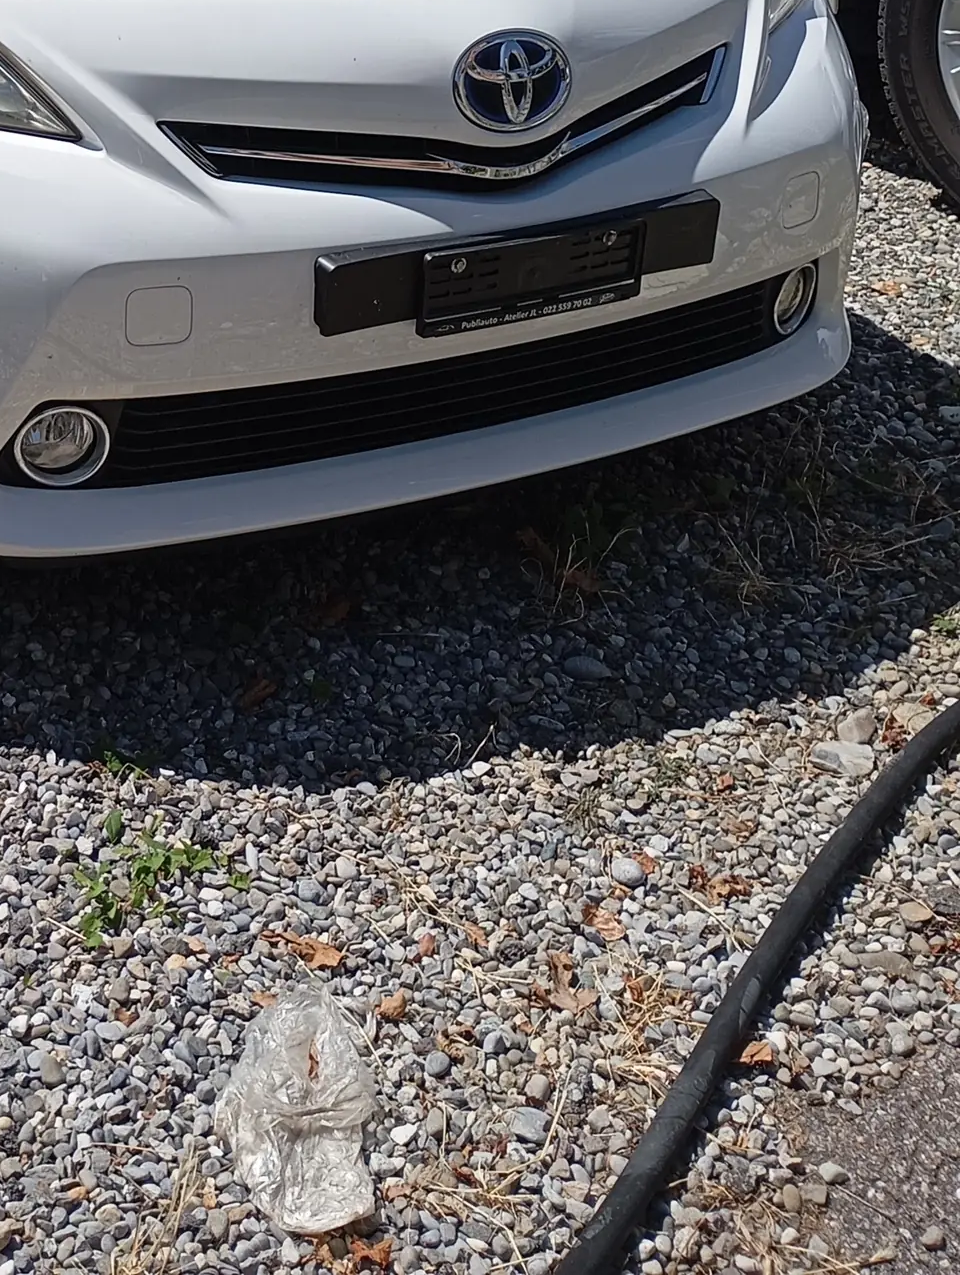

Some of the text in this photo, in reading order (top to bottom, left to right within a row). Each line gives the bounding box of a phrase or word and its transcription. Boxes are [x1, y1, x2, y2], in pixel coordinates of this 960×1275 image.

[461, 317, 498, 329] Publiauto
[503, 311, 529, 322] Atelier
[543, 305, 557, 314] 022
[558, 301, 572, 311] 559
[572, 299, 582, 308] 70
[582, 298, 593, 306] 02
